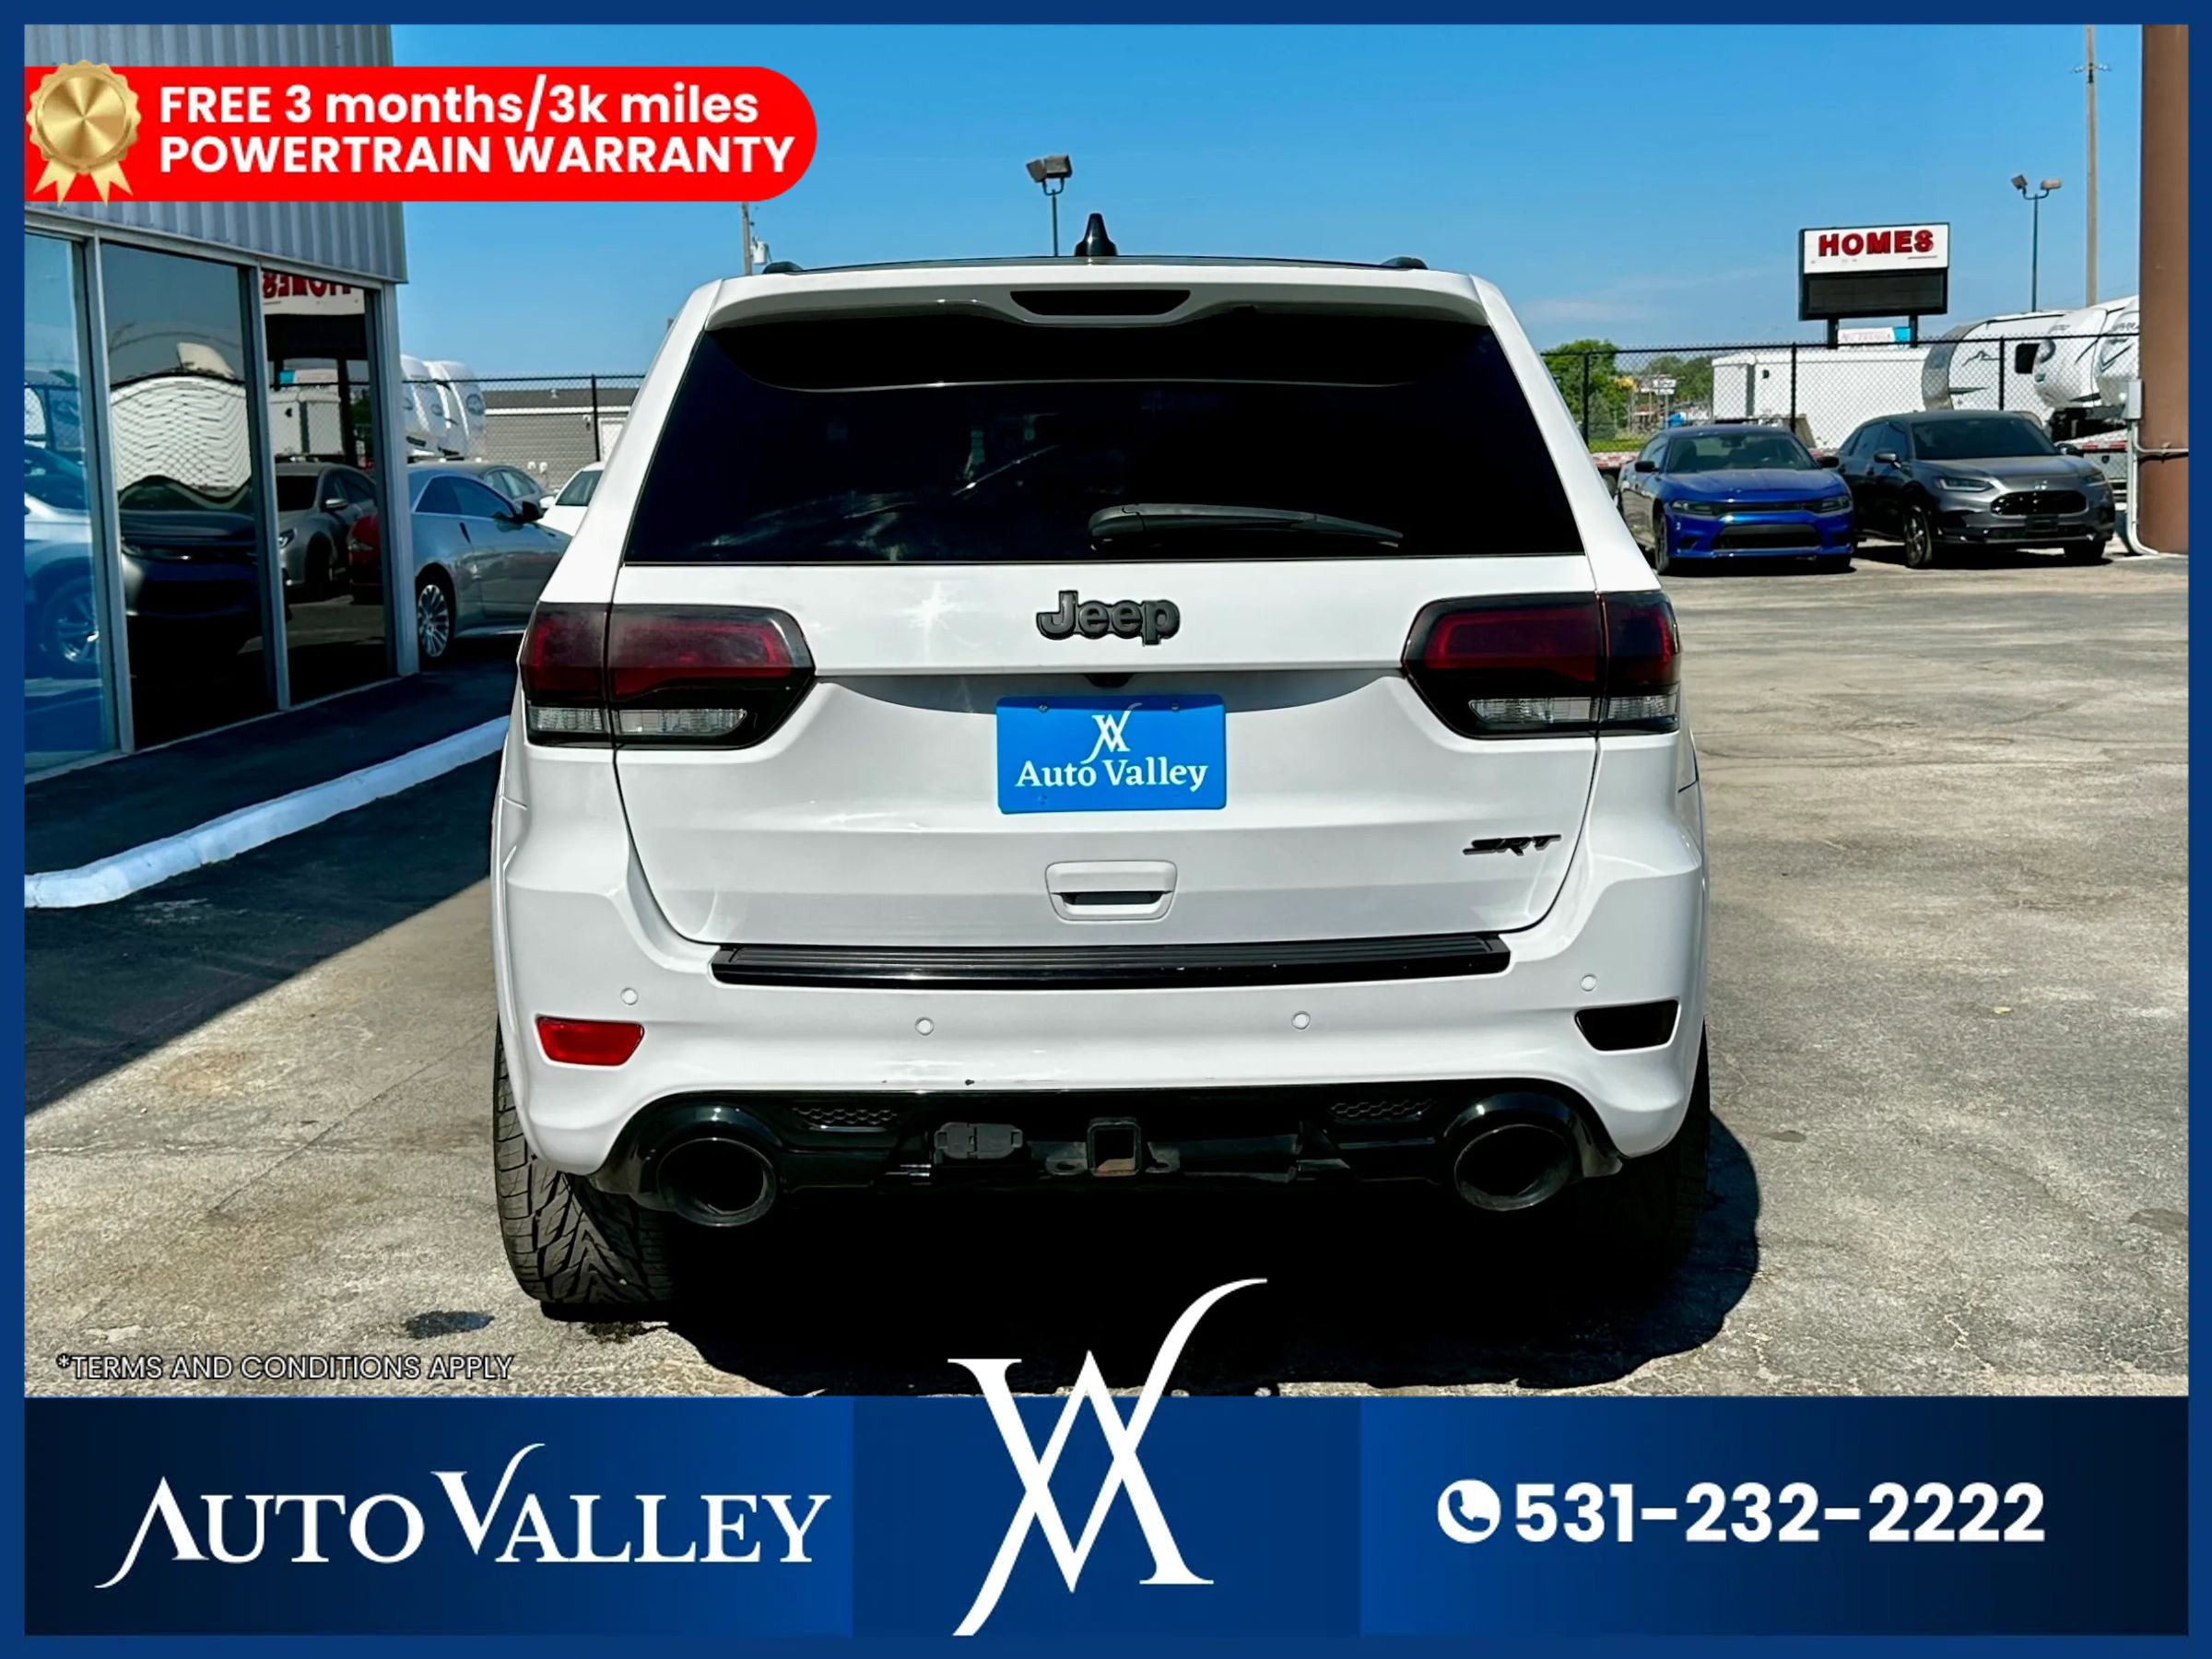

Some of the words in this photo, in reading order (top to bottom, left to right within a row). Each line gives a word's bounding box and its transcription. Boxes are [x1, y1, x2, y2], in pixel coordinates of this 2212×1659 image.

[1818, 229, 1934, 256] HOMES
[1036, 590, 1180, 645] Jeep
[1015, 759, 1097, 787] Auto
[1101, 756, 1208, 793] Valley
[1462, 834, 1561, 856] SRT
